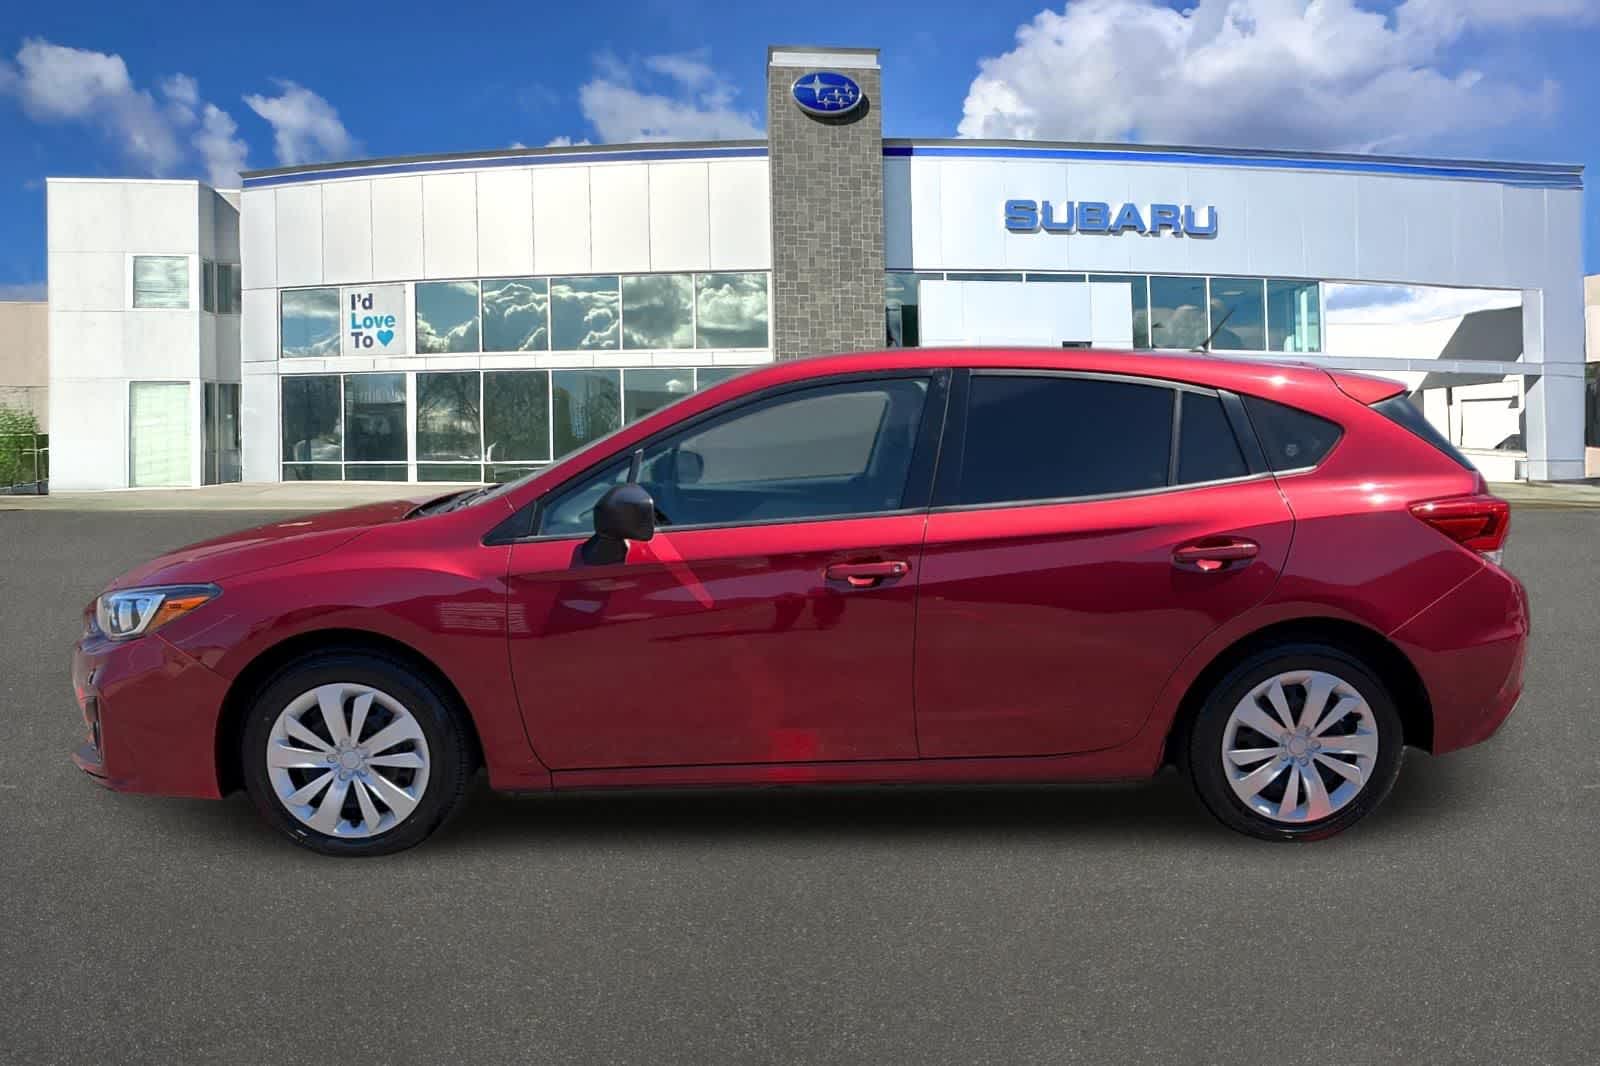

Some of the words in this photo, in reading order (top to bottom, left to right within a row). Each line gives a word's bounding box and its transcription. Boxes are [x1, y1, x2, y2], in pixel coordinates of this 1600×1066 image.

[1005, 199, 1217, 237] SUBARU
[351, 293, 373, 310] I'd
[351, 312, 396, 330] Love
[351, 331, 374, 348] To
